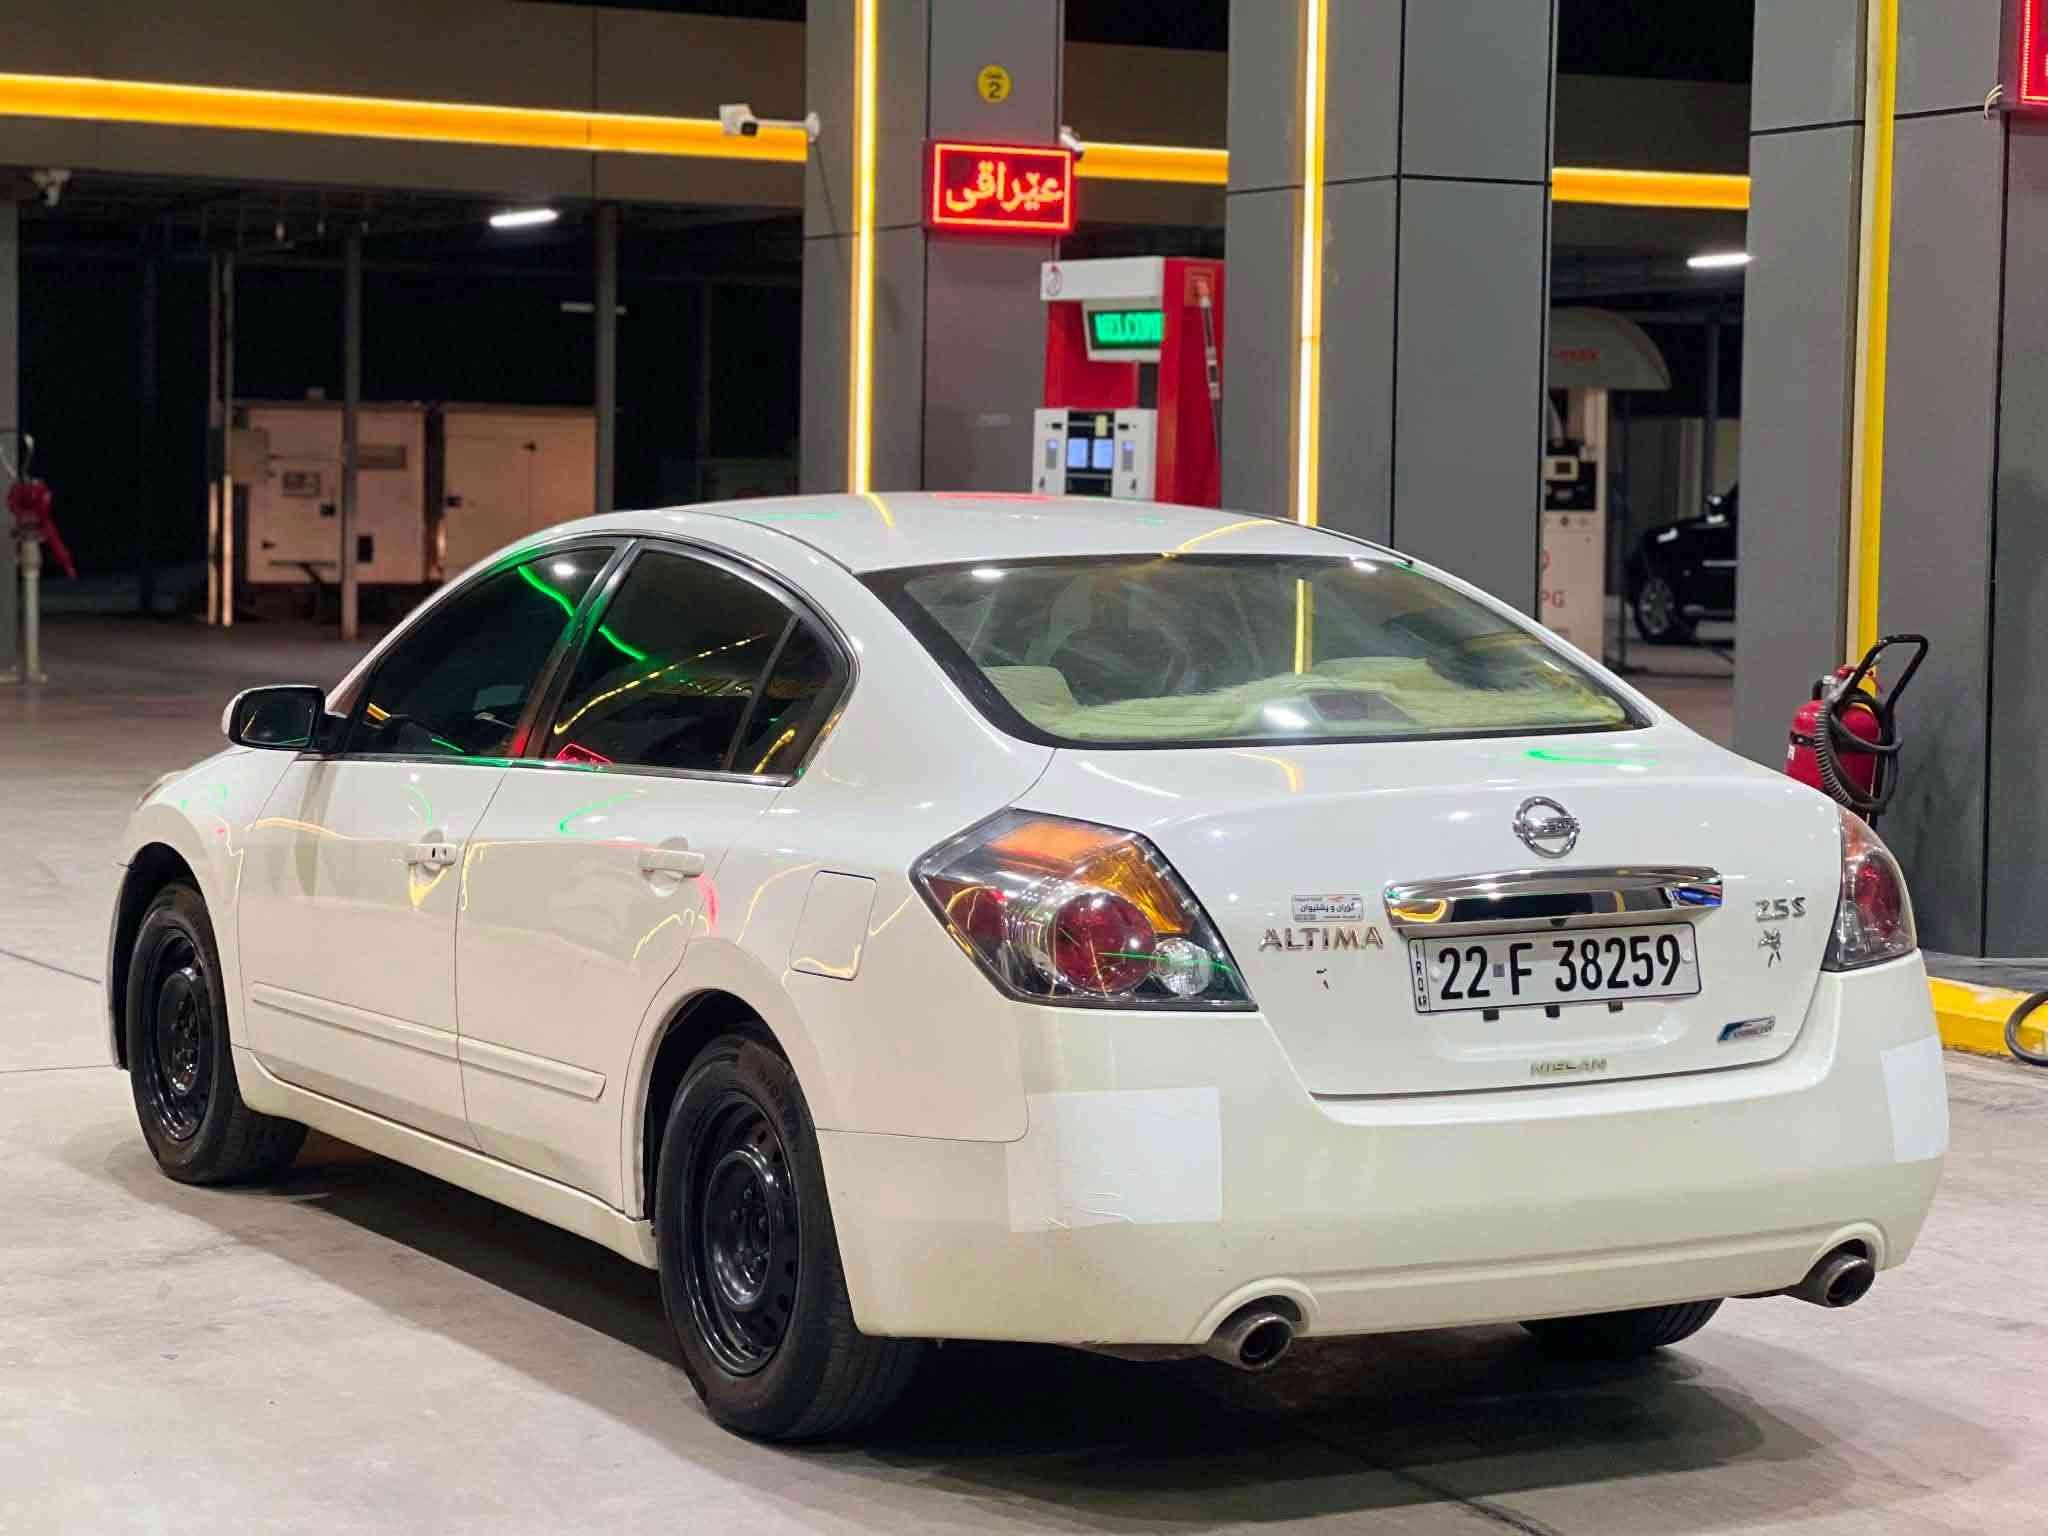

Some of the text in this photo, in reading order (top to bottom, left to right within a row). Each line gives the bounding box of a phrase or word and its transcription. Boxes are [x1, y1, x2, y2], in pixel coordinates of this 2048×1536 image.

[988, 80, 1002, 99] 2
[1257, 926, 1384, 951] ALTIMA
[1438, 933, 1681, 1000] 22 F 38259
